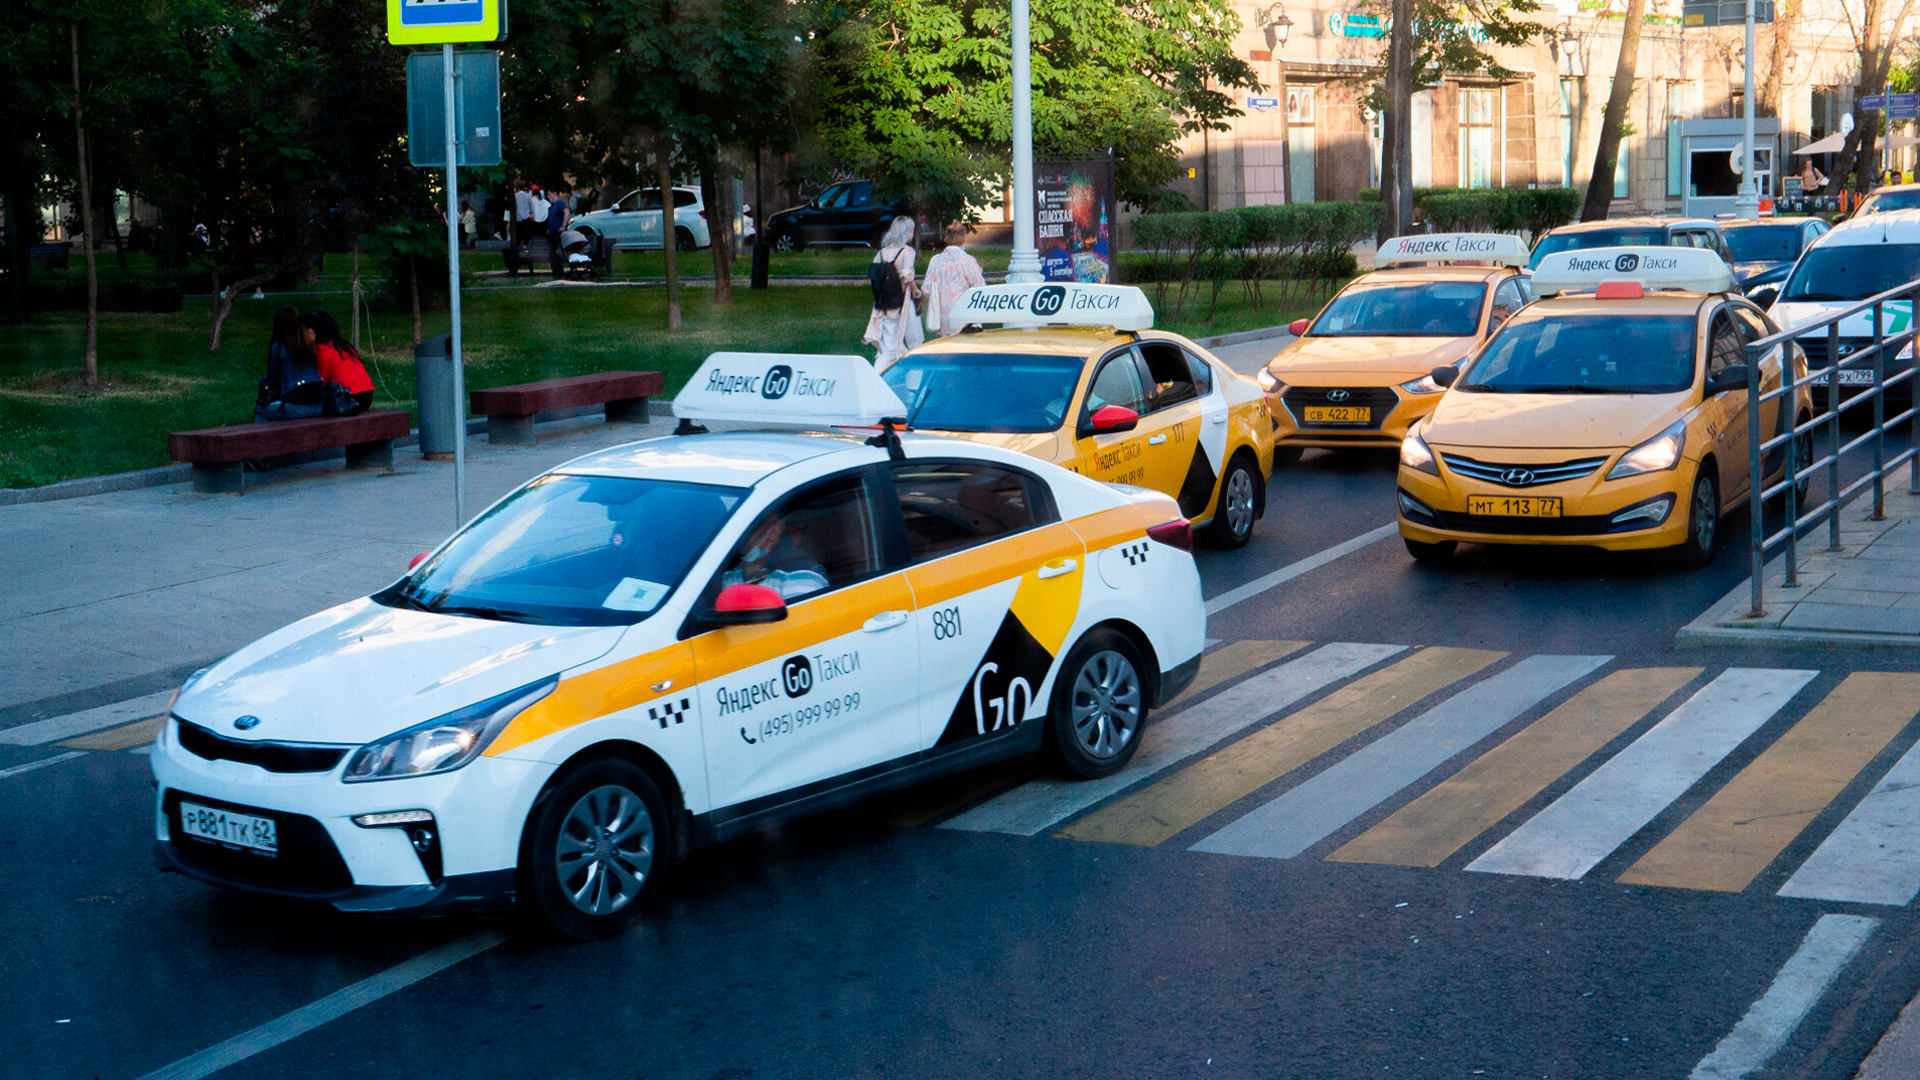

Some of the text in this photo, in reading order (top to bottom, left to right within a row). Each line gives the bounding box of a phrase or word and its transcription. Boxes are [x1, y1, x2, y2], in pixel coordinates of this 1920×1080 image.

[1039, 209, 1073, 223] СПАССКАЯ
[1039, 224, 1064, 238] БАШНЯ
[1397, 236, 1496, 255] Яндекс Такси
[1568, 254, 1677, 272] Яндекс Go Такси
[967, 287, 1120, 313] Яндекс Go Такси
[705, 368, 836, 397] Яндекс Go Такси
[1328, 409, 1349, 420] 422
[1093, 442, 1142, 473] Яндекс Такси
[1503, 500, 1530, 514] 113
[1540, 500, 1555, 511] 77
[933, 606, 962, 640] 881
[716, 651, 861, 717] Яндекс Go Такси
[973, 661, 1032, 735] Go
[758, 692, 860, 744] (495) 999 99 99
